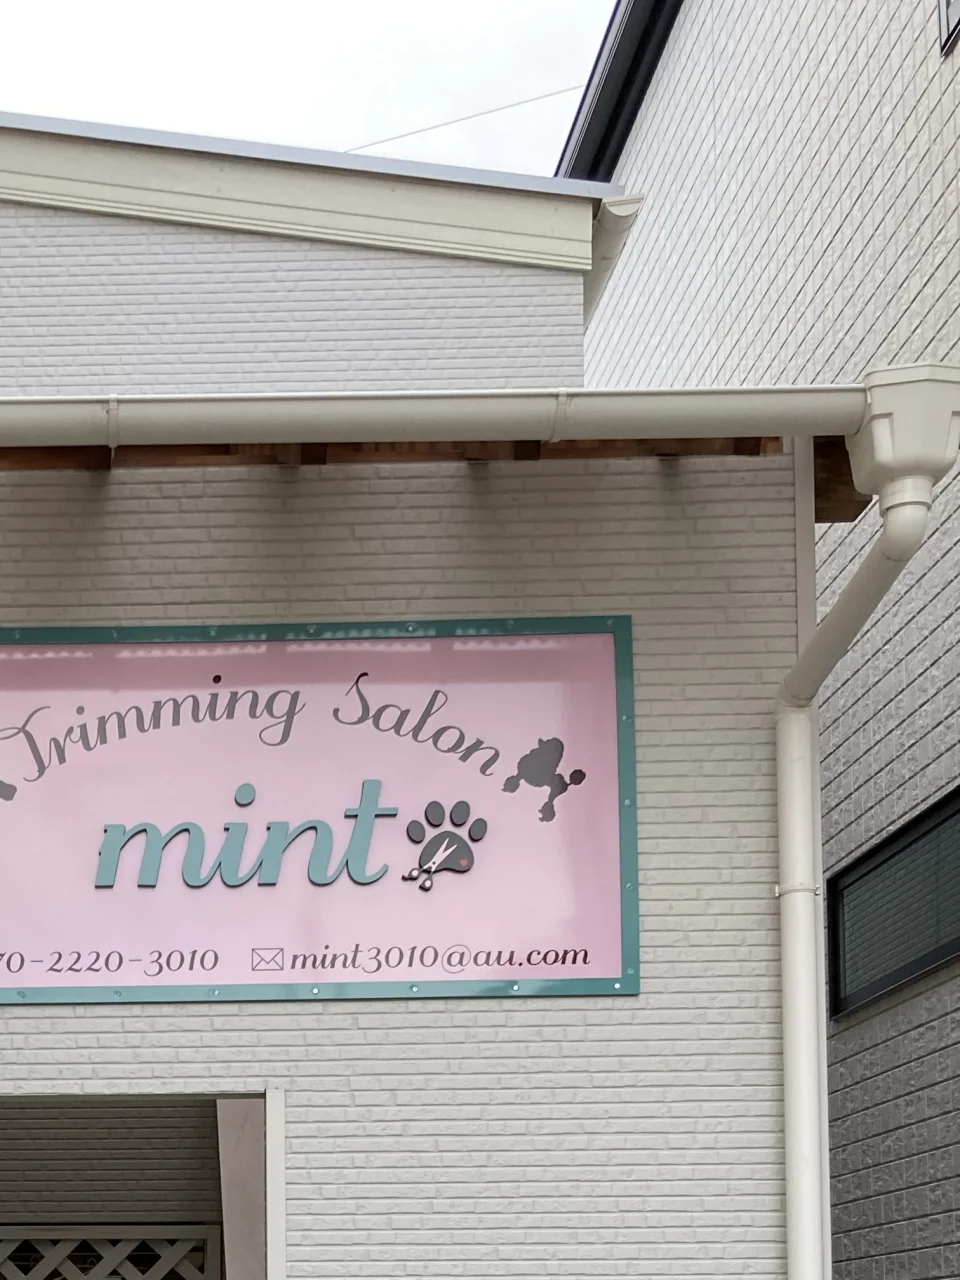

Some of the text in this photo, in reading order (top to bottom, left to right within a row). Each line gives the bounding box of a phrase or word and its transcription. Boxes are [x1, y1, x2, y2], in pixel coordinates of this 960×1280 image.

[332, 672, 501, 778] Salon
[94, 778, 398, 889] mint
[290, 941, 591, 973] mint3010@au.com
